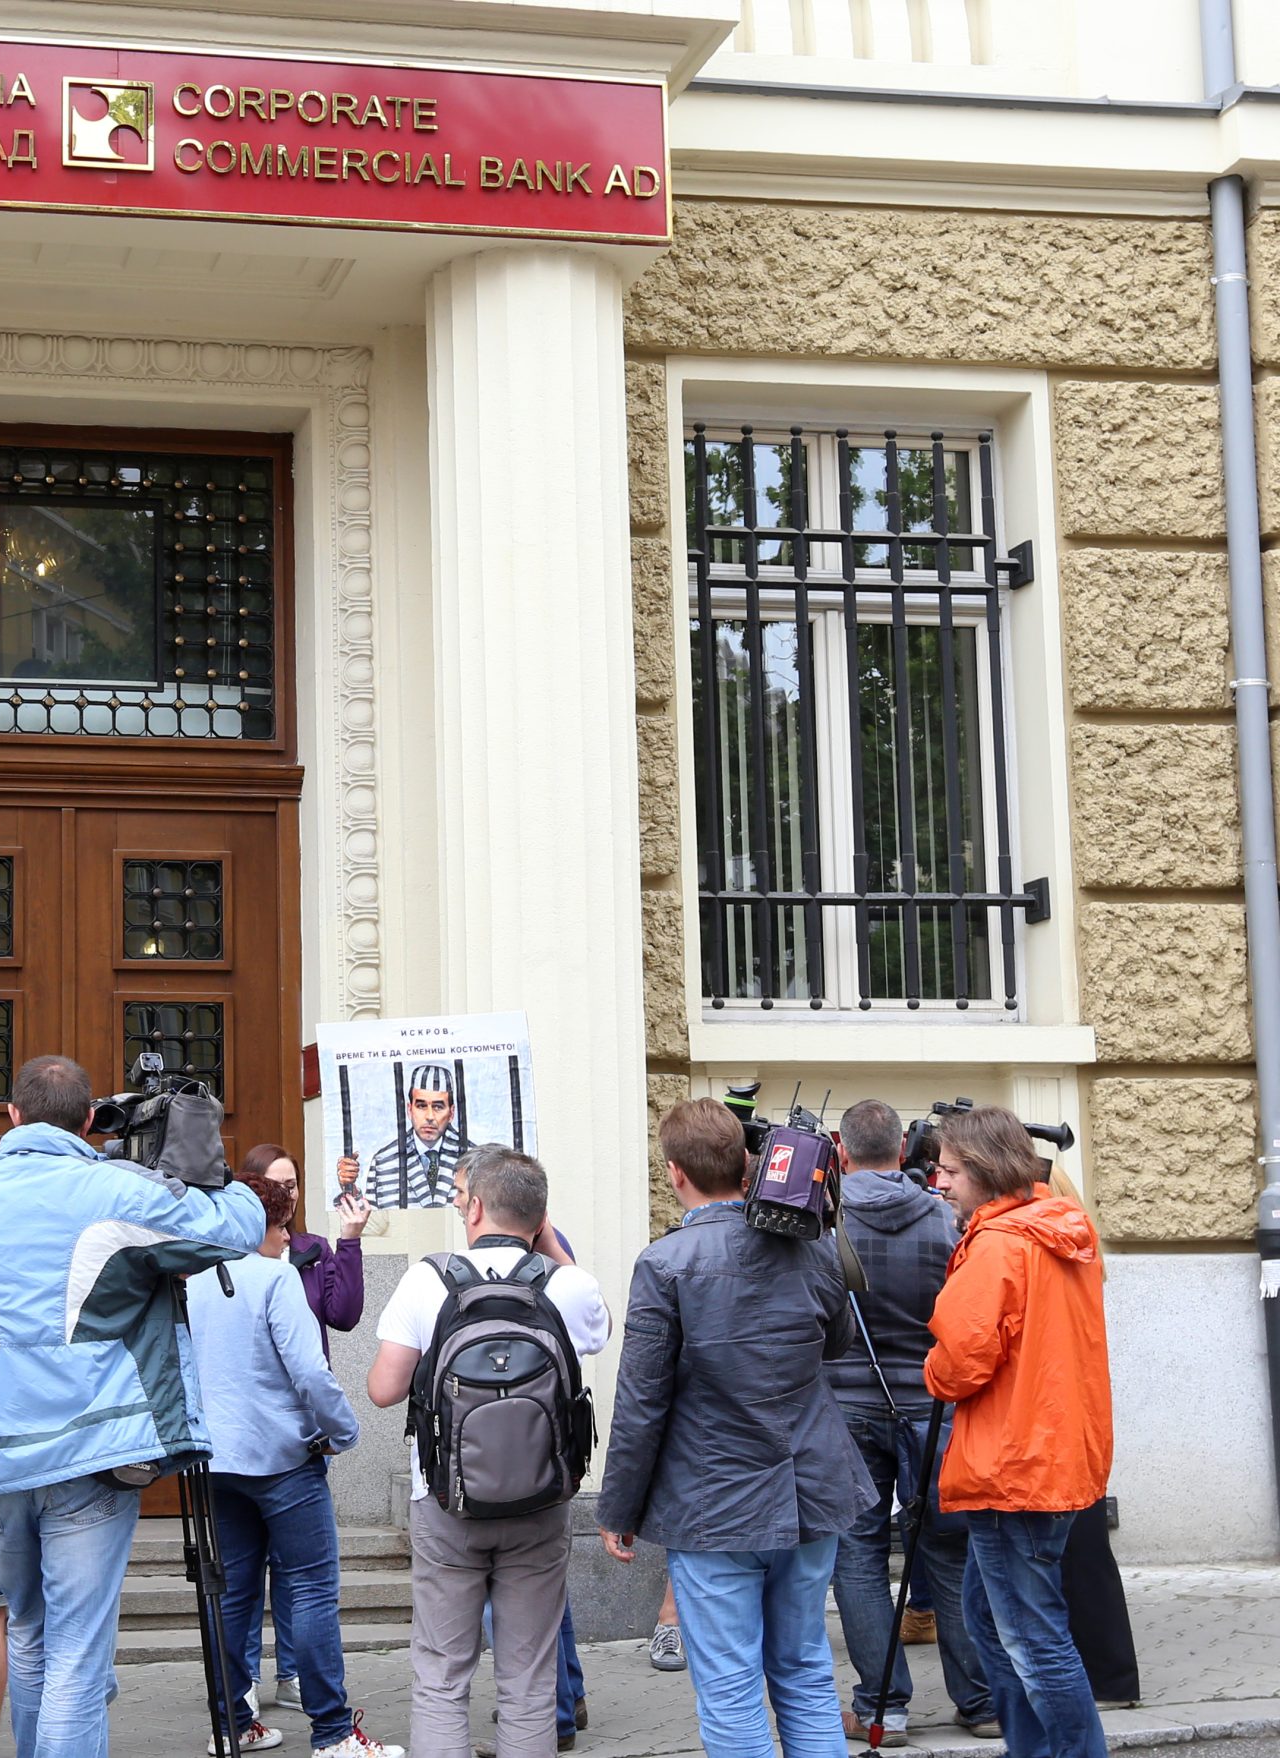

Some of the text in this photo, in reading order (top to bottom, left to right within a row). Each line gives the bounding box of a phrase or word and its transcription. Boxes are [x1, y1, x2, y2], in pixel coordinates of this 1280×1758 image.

[172, 82, 439, 132] CORPORATE
[174, 138, 661, 198] COMMERCIAL BANK AD
[400, 1027, 454, 1037] ИСКРОВ,
[335, 1051, 365, 1060] ВРЕМЕ
[381, 1050, 387, 1058] Е
[389, 1049, 402, 1057] ДА
[406, 1047, 446, 1056] СМЕНИШ
[450, 1043, 516, 1054] КОСТЮМЧЕТО!
